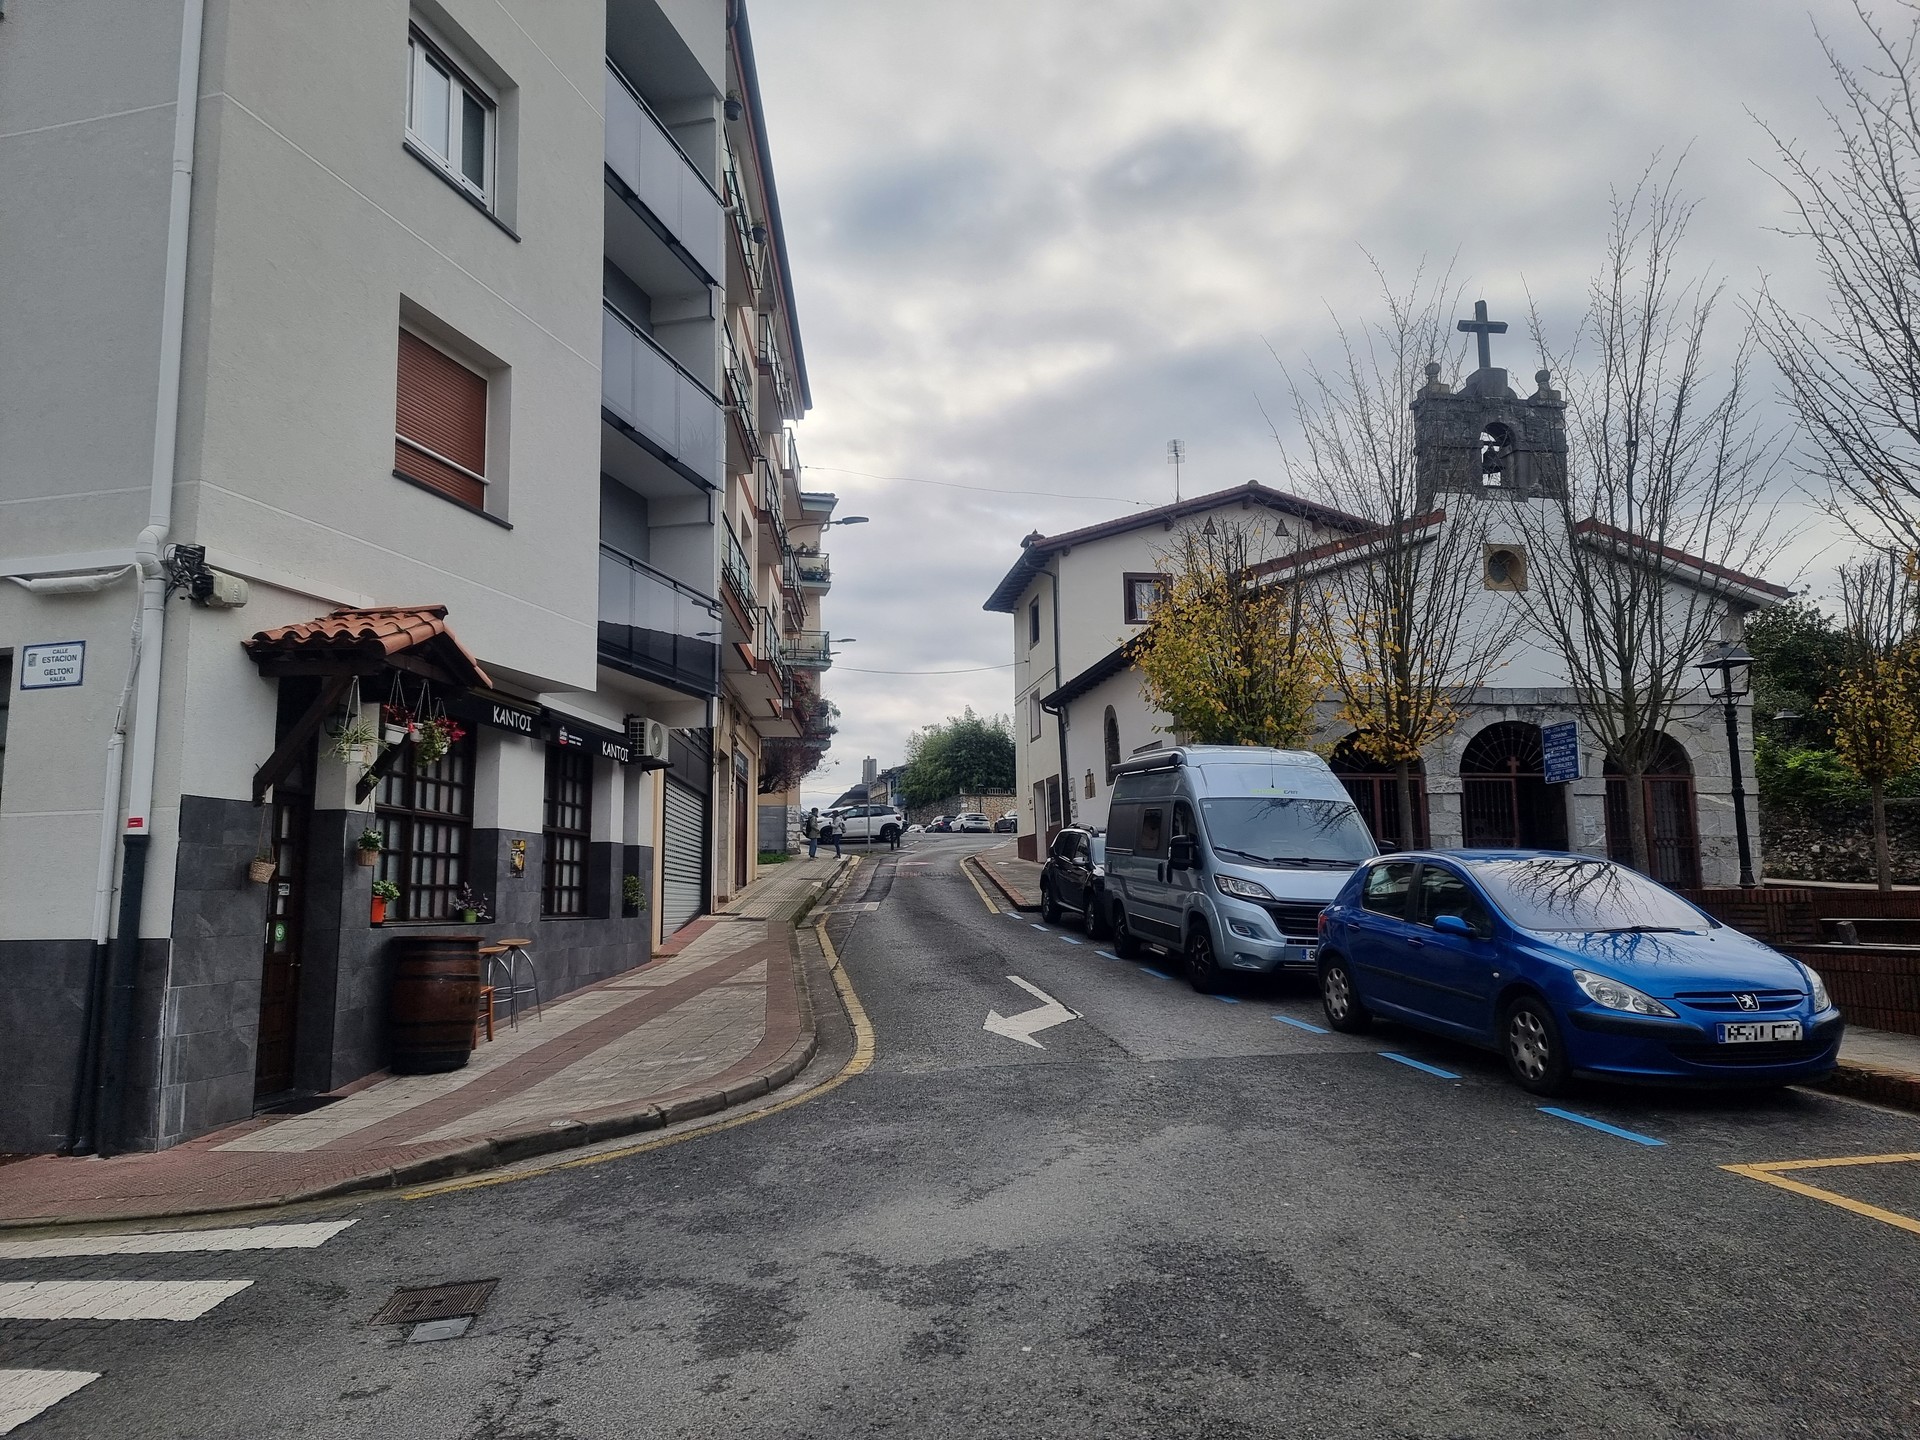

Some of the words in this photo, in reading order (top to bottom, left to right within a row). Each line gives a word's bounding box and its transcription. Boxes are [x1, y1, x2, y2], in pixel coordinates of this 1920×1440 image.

[43, 667, 74, 676] GELTOKI
[493, 705, 532, 732] KANTOI
[602, 741, 629, 762] KANTOI
